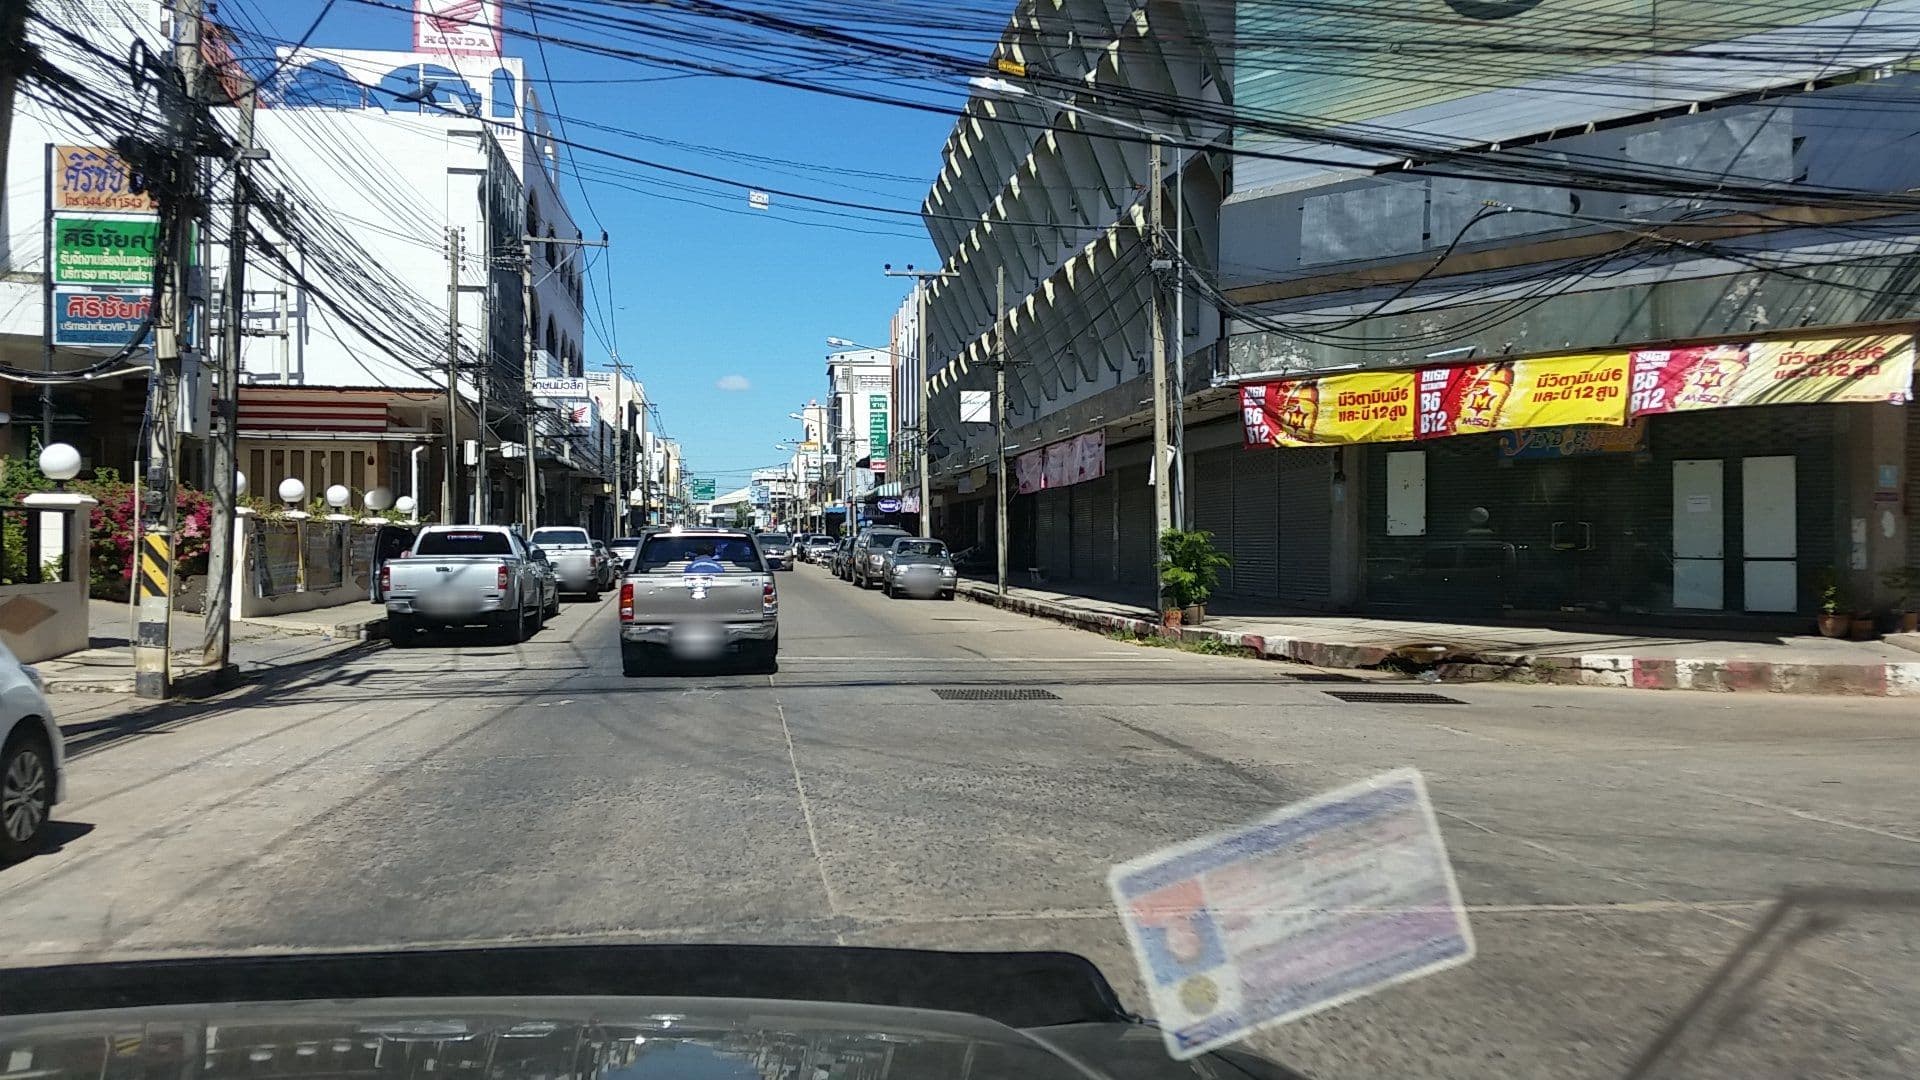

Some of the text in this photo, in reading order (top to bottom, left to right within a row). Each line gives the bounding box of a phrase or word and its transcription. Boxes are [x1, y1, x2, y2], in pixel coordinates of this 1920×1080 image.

[424, 35, 489, 47] HONDA
[1422, 368, 1449, 382] HIGH
[1536, 368, 1623, 388] มีวิตามินบี6
[1633, 372, 1659, 391] B6
[1338, 387, 1408, 406] มีวิตามินบี6
[1421, 392, 1440, 412] B6
[1631, 389, 1665, 413] B12
[1244, 408, 1263, 426] B6
[1421, 411, 1447, 433] B12
[1246, 426, 1270, 443] B12
